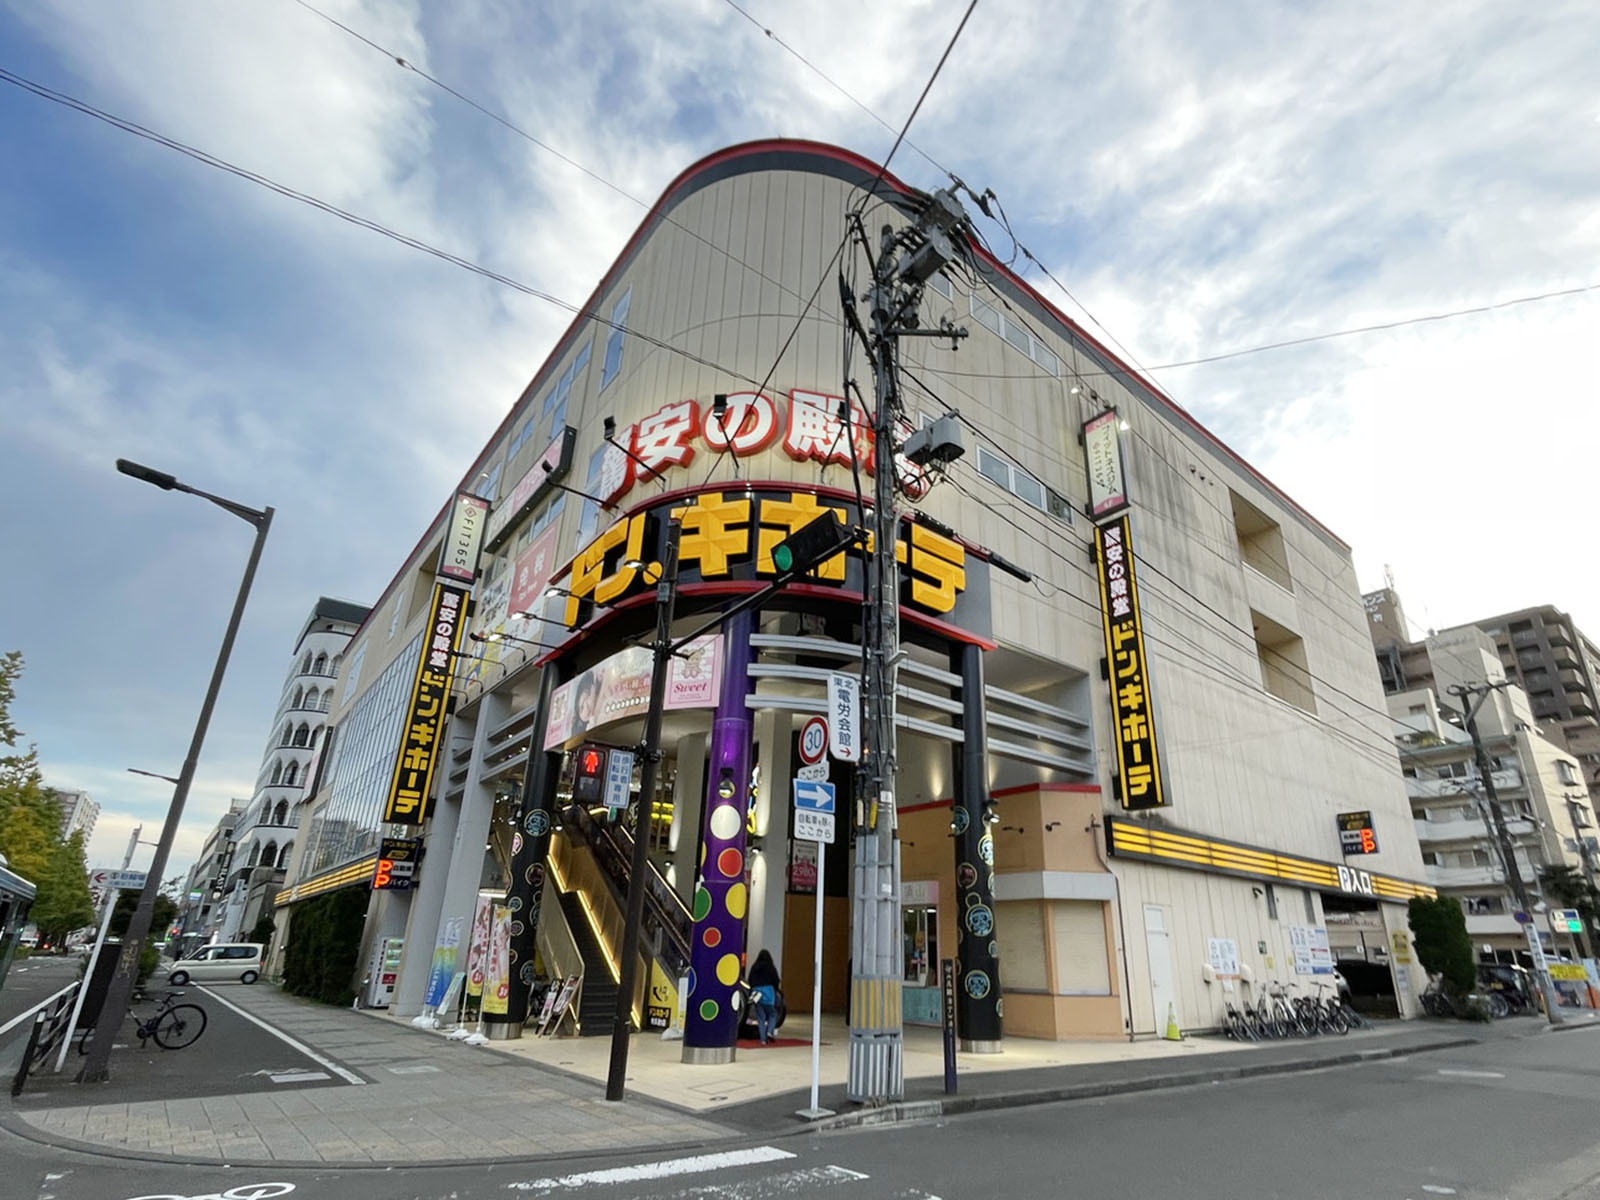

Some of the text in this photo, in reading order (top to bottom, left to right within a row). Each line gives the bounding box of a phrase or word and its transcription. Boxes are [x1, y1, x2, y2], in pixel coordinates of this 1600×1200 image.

[455, 517, 474, 567] FIT365
[674, 682, 707, 693] Sweet
[833, 677, 853, 690] 東北
[805, 728, 822, 751] 30
[798, 824, 832, 839] ここから
[390, 878, 409, 887] バイク
